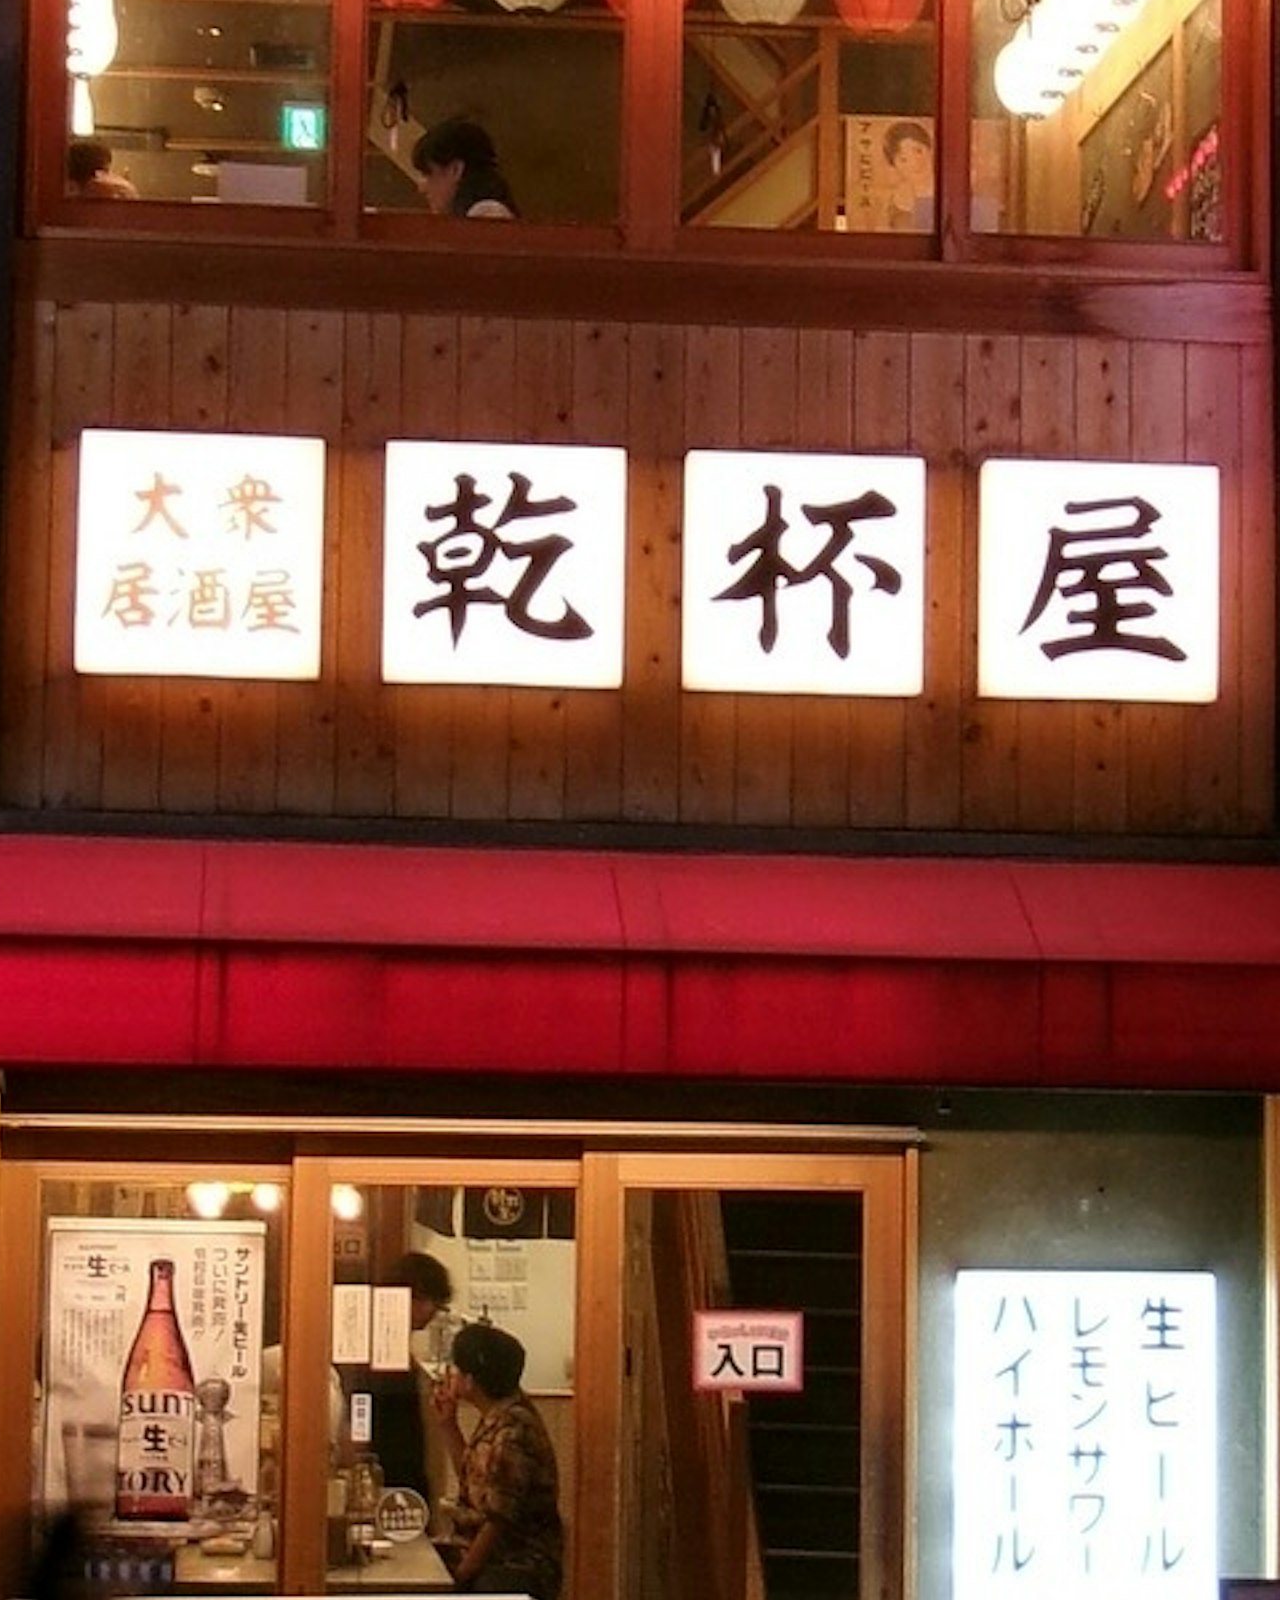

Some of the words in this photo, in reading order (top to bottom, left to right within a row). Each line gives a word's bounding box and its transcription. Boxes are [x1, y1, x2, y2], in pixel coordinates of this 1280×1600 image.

[131, 472, 283, 541] 大衆
[102, 562, 300, 636] 居酒屋
[412, 470, 1186, 661] 乾杯屋
[231, 1247, 251, 1378] サントリー生ビール
[710, 1343, 785, 1378] 入口
[1068, 1295, 1109, 1573] レモンサワー
